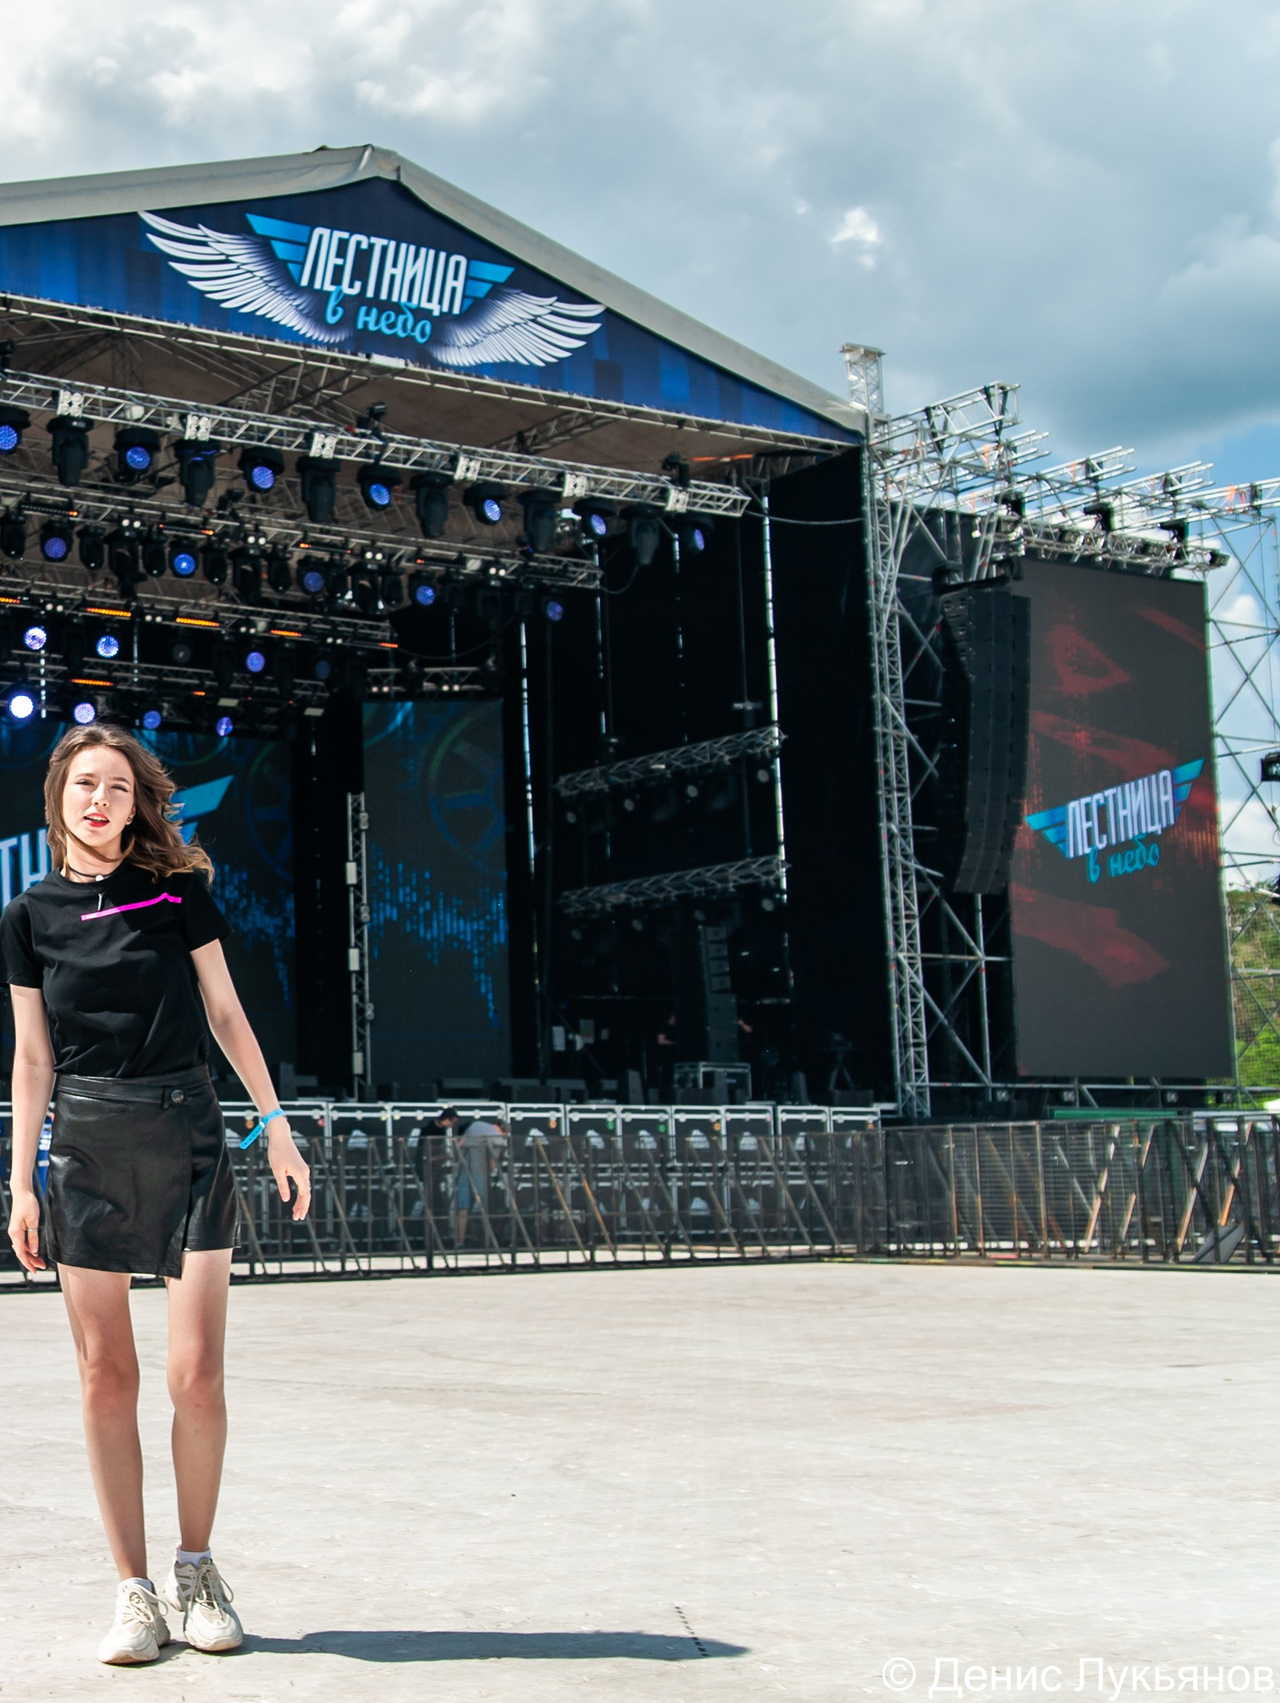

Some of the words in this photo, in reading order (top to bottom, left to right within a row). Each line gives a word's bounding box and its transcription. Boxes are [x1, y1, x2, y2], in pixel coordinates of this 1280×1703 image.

[300, 227, 467, 316] ЛЕСТНИЦА
[325, 286, 345, 325] в
[356, 302, 433, 344] небо
[1067, 769, 1175, 859] ЛЕСТНИЦА
[1087, 845, 1101, 883] в
[1108, 833, 1160, 877] небо
